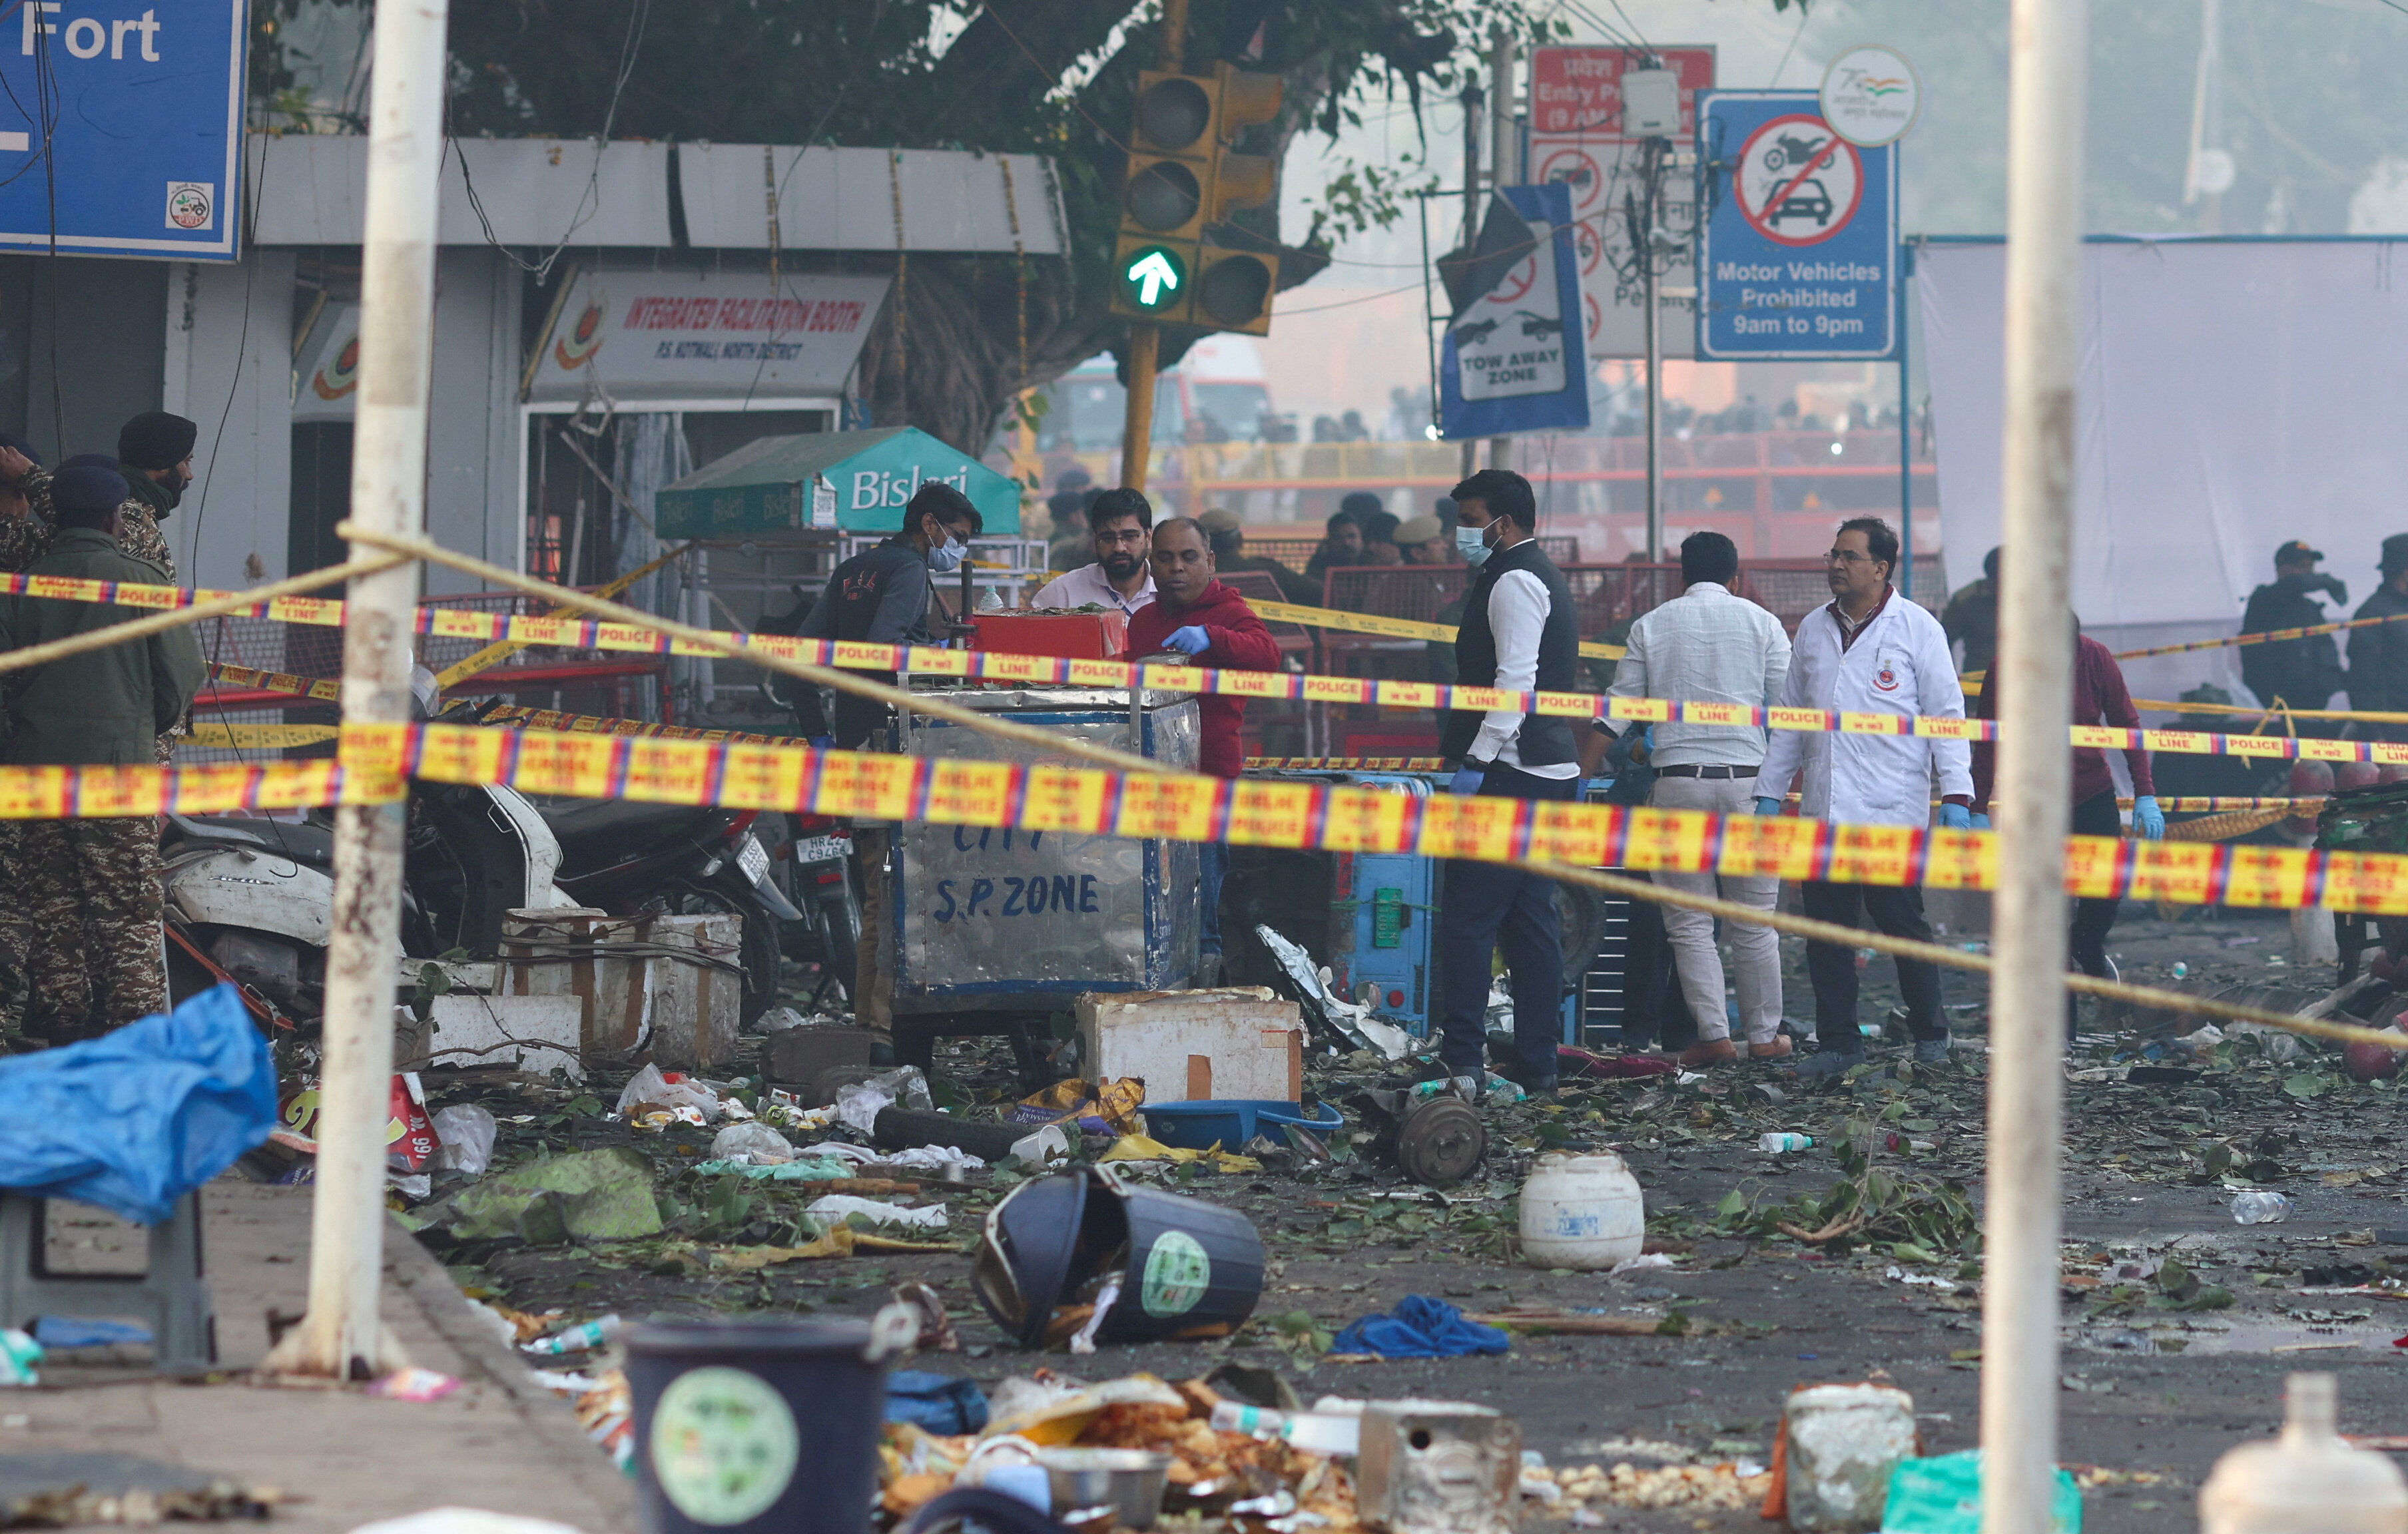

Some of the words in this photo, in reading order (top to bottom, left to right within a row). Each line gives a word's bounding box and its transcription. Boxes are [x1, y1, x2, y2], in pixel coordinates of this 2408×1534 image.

[22, 1, 160, 62] Fort
[1538, 83, 1594, 107] Entry
[1716, 262, 1782, 280] Motor
[1787, 262, 1881, 280] Vehicles
[1741, 288, 1857, 307] Prohibited
[623, 297, 718, 330] INTEGRATED
[713, 298, 814, 331] FACILITATION
[807, 301, 866, 332] BOOTH
[1733, 315, 1780, 334] 9am
[1787, 317, 1809, 334] to
[1815, 315, 1863, 338] 9pm
[1464, 355, 1502, 370] TOW
[1510, 349, 1558, 366] AWAY
[1488, 368, 1536, 385] ZONE
[119, 587, 171, 605] POLICE
[286, 607, 317, 619] LINE
[525, 627, 556, 639] LINE
[599, 628, 651, 642] POLICE
[838, 646, 888, 660] POLICE
[1000, 664, 1031, 675] LINE
[1073, 664, 1124, 678] POLICE
[1234, 680, 1265, 692] LINE
[1307, 680, 1358, 694] POLICE
[1468, 696, 1499, 707] LINE
[1540, 696, 1590, 708] POLICE
[1699, 710, 1730, 722] LINE
[1772, 711, 1821, 723] POLICE
[1930, 724, 1960, 736] LINE
[2159, 738, 2190, 749] LINE
[2230, 739, 2279, 750] POLICE
[933, 878, 994, 924] S.P.
[1002, 874, 1099, 917] ZONE
